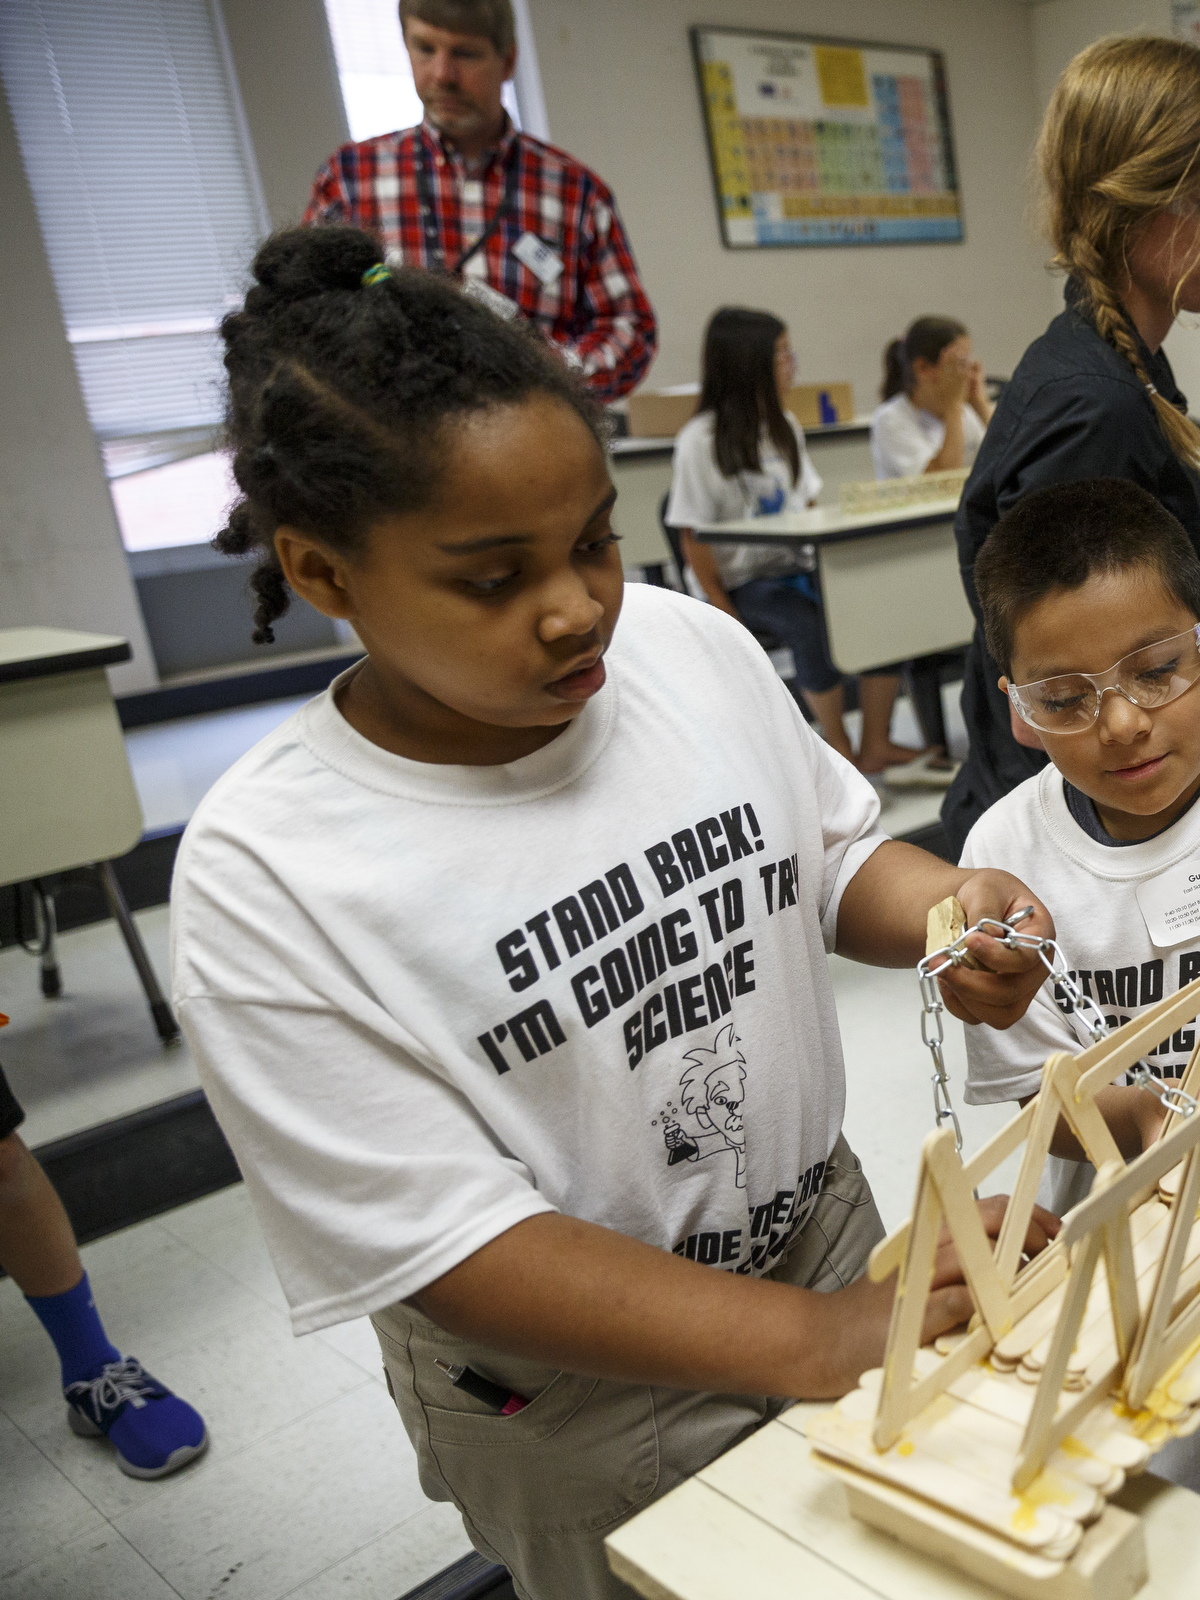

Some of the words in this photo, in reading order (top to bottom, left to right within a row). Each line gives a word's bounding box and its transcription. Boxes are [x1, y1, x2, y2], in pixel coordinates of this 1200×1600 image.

[477, 999, 567, 1075] I'M
[570, 908, 698, 1028] GOING
[698, 878, 745, 943] TO
[759, 853, 799, 916] TRY
[495, 862, 645, 993] STAND
[644, 802, 764, 898] BACK!
[1053, 958, 1164, 1014] STAND
